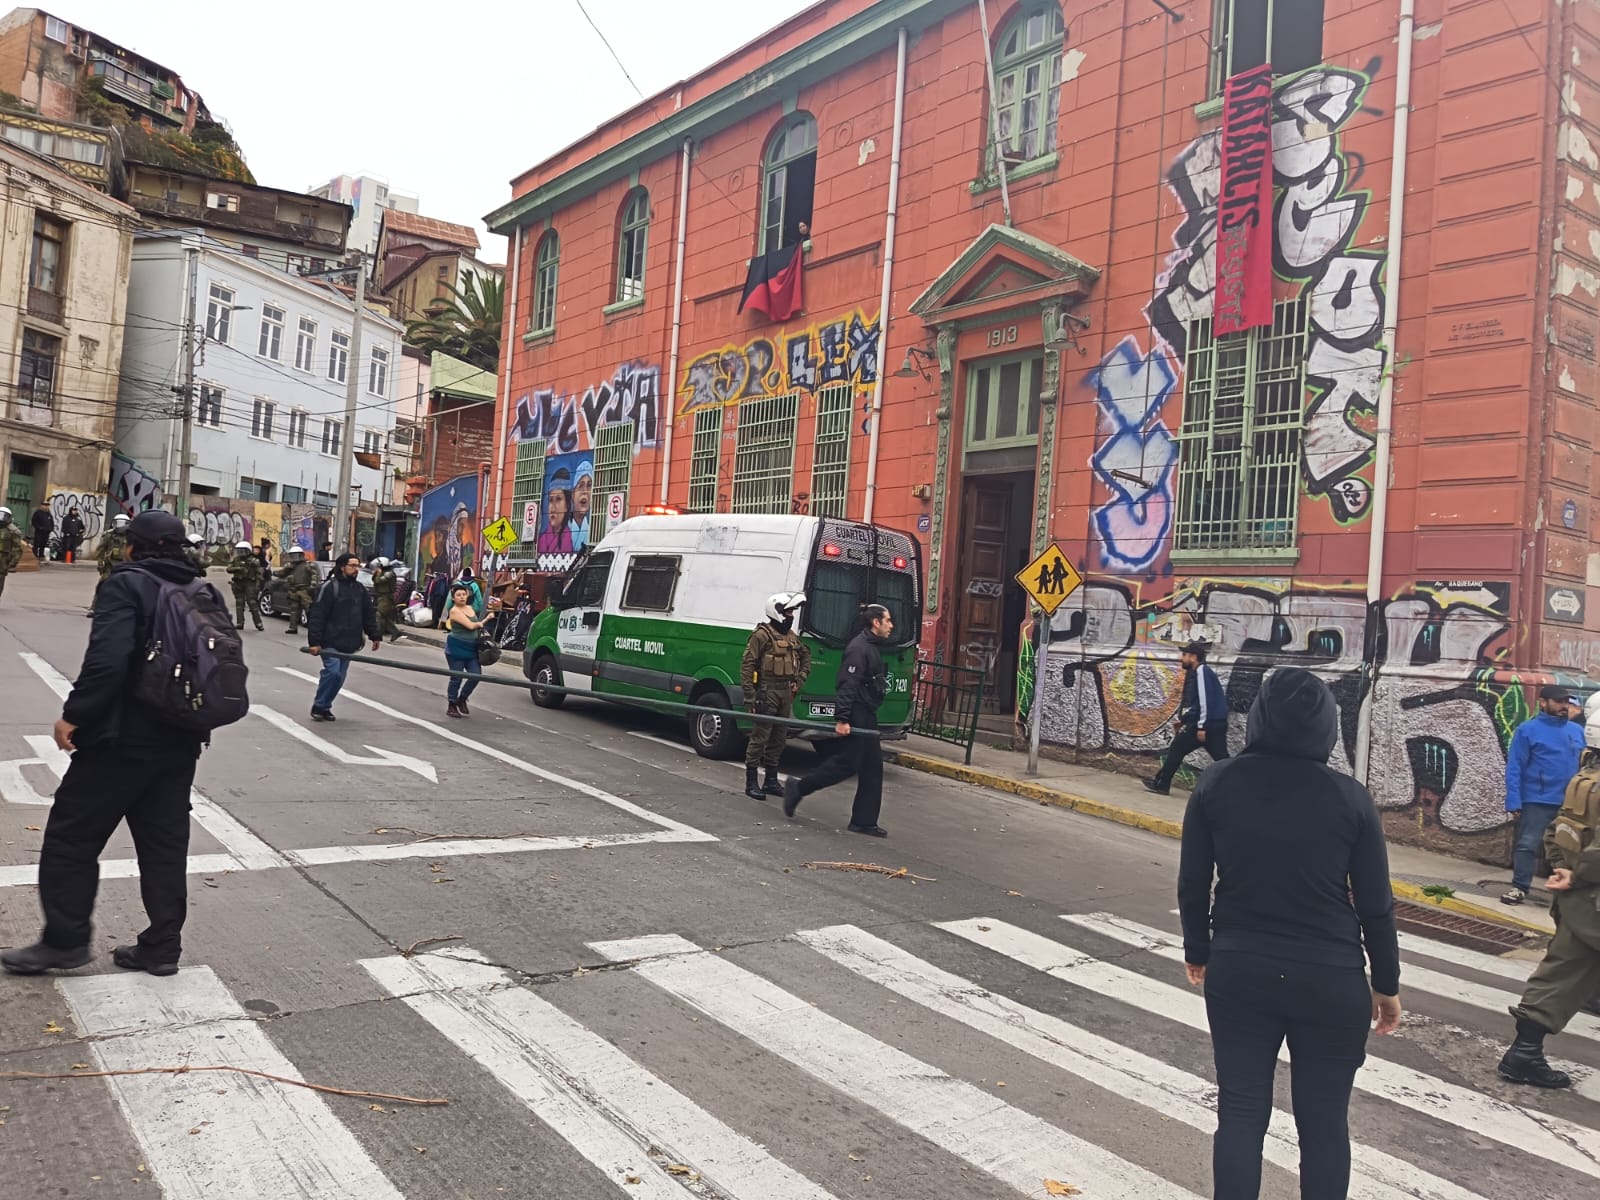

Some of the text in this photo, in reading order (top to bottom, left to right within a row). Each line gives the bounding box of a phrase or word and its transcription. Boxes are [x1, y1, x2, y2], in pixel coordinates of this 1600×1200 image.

[986, 325, 1017, 348] 1913
[835, 526, 868, 543] CUARTEL
[558, 617, 569, 630] CM
[615, 636, 665, 655] CUARTEL MOVIL
[895, 678, 908, 692] 7420
